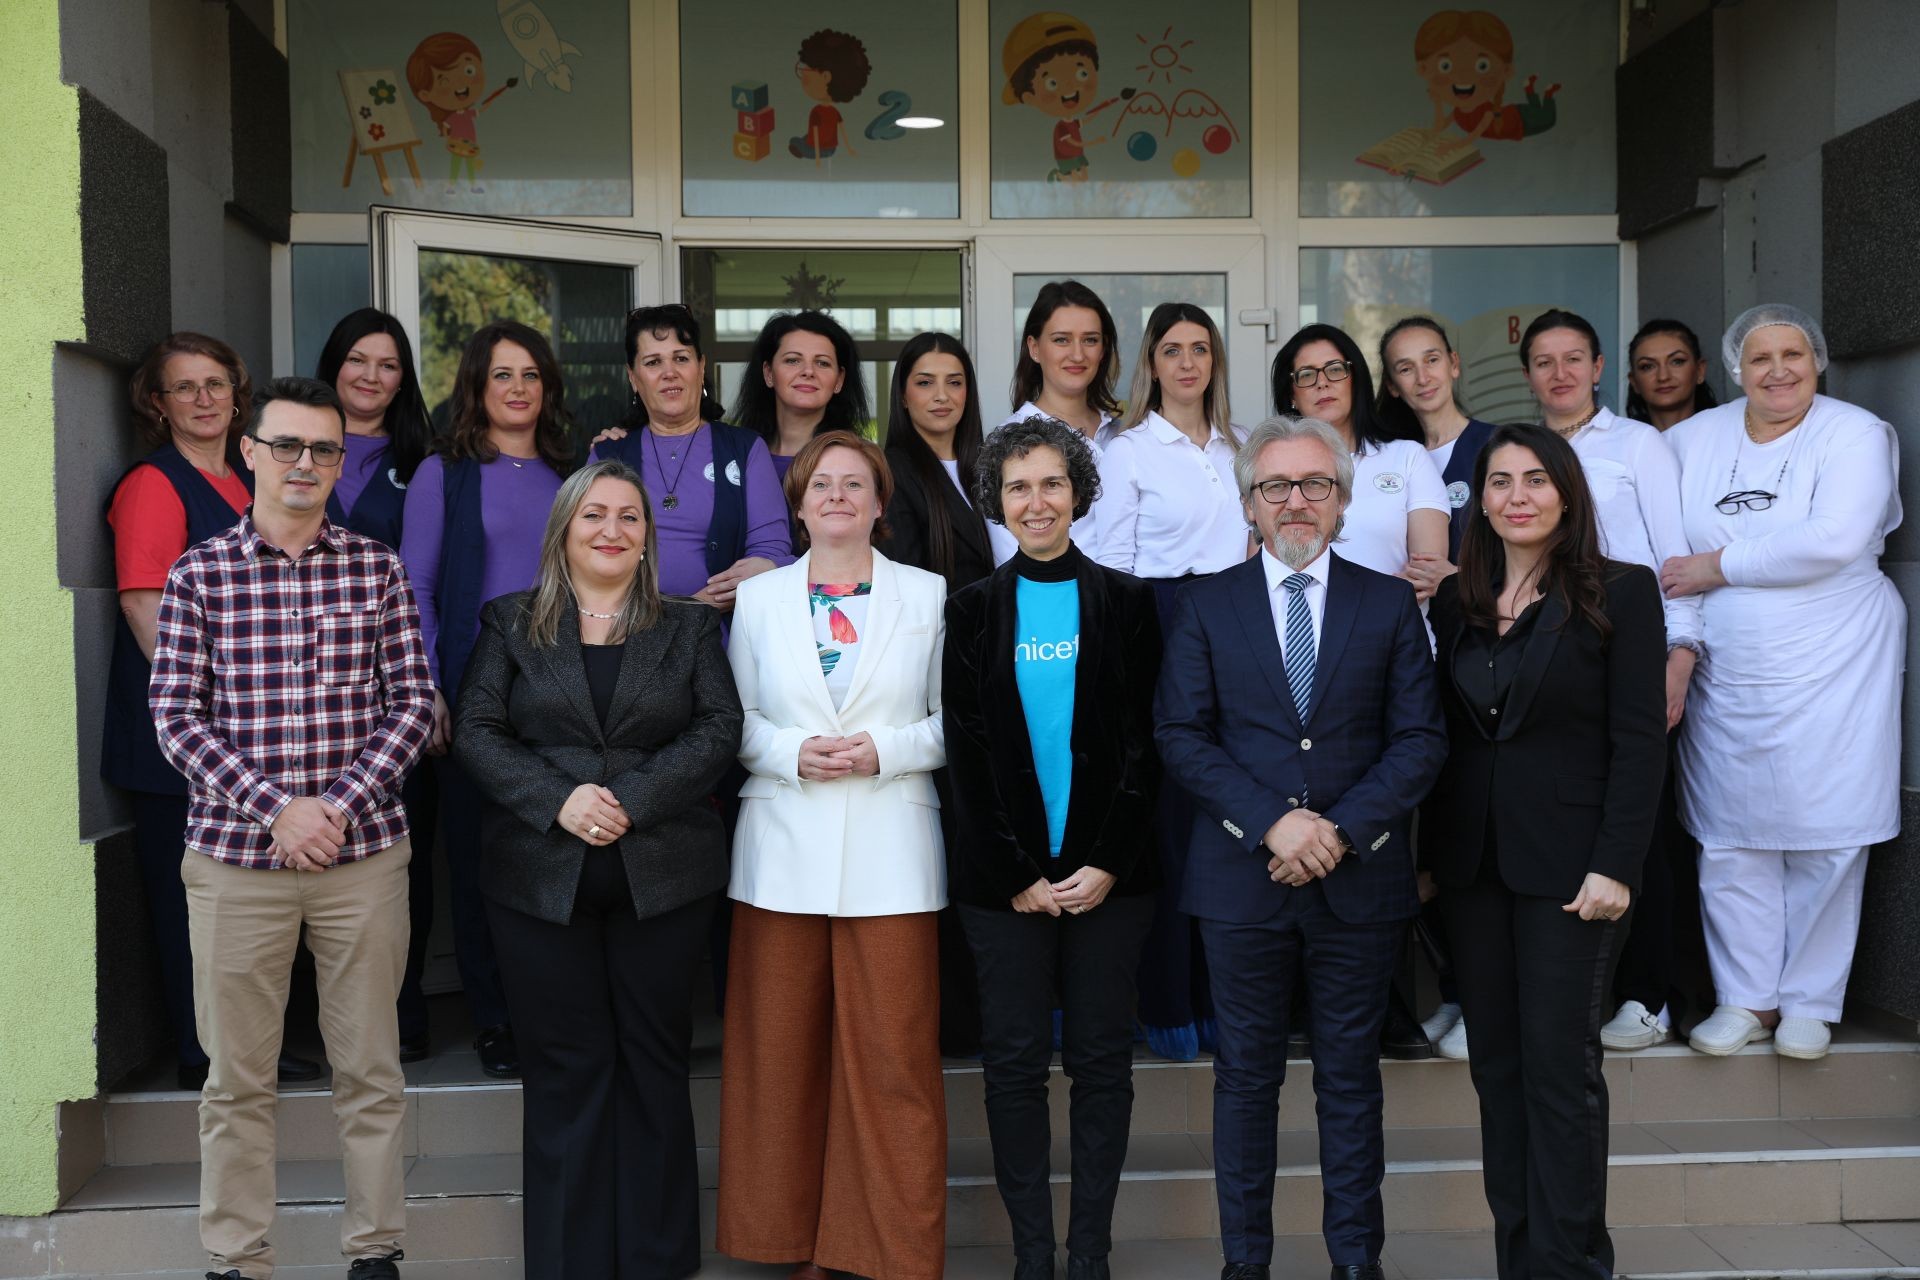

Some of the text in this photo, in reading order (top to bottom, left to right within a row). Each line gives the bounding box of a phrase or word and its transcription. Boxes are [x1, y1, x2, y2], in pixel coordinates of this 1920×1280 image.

[735, 91, 750, 107] A
[743, 115, 755, 132] B
[864, 90, 912, 141] 2
[737, 142, 752, 156] C
[1508, 315, 1521, 345] B
[1014, 633, 1080, 663] nicef
